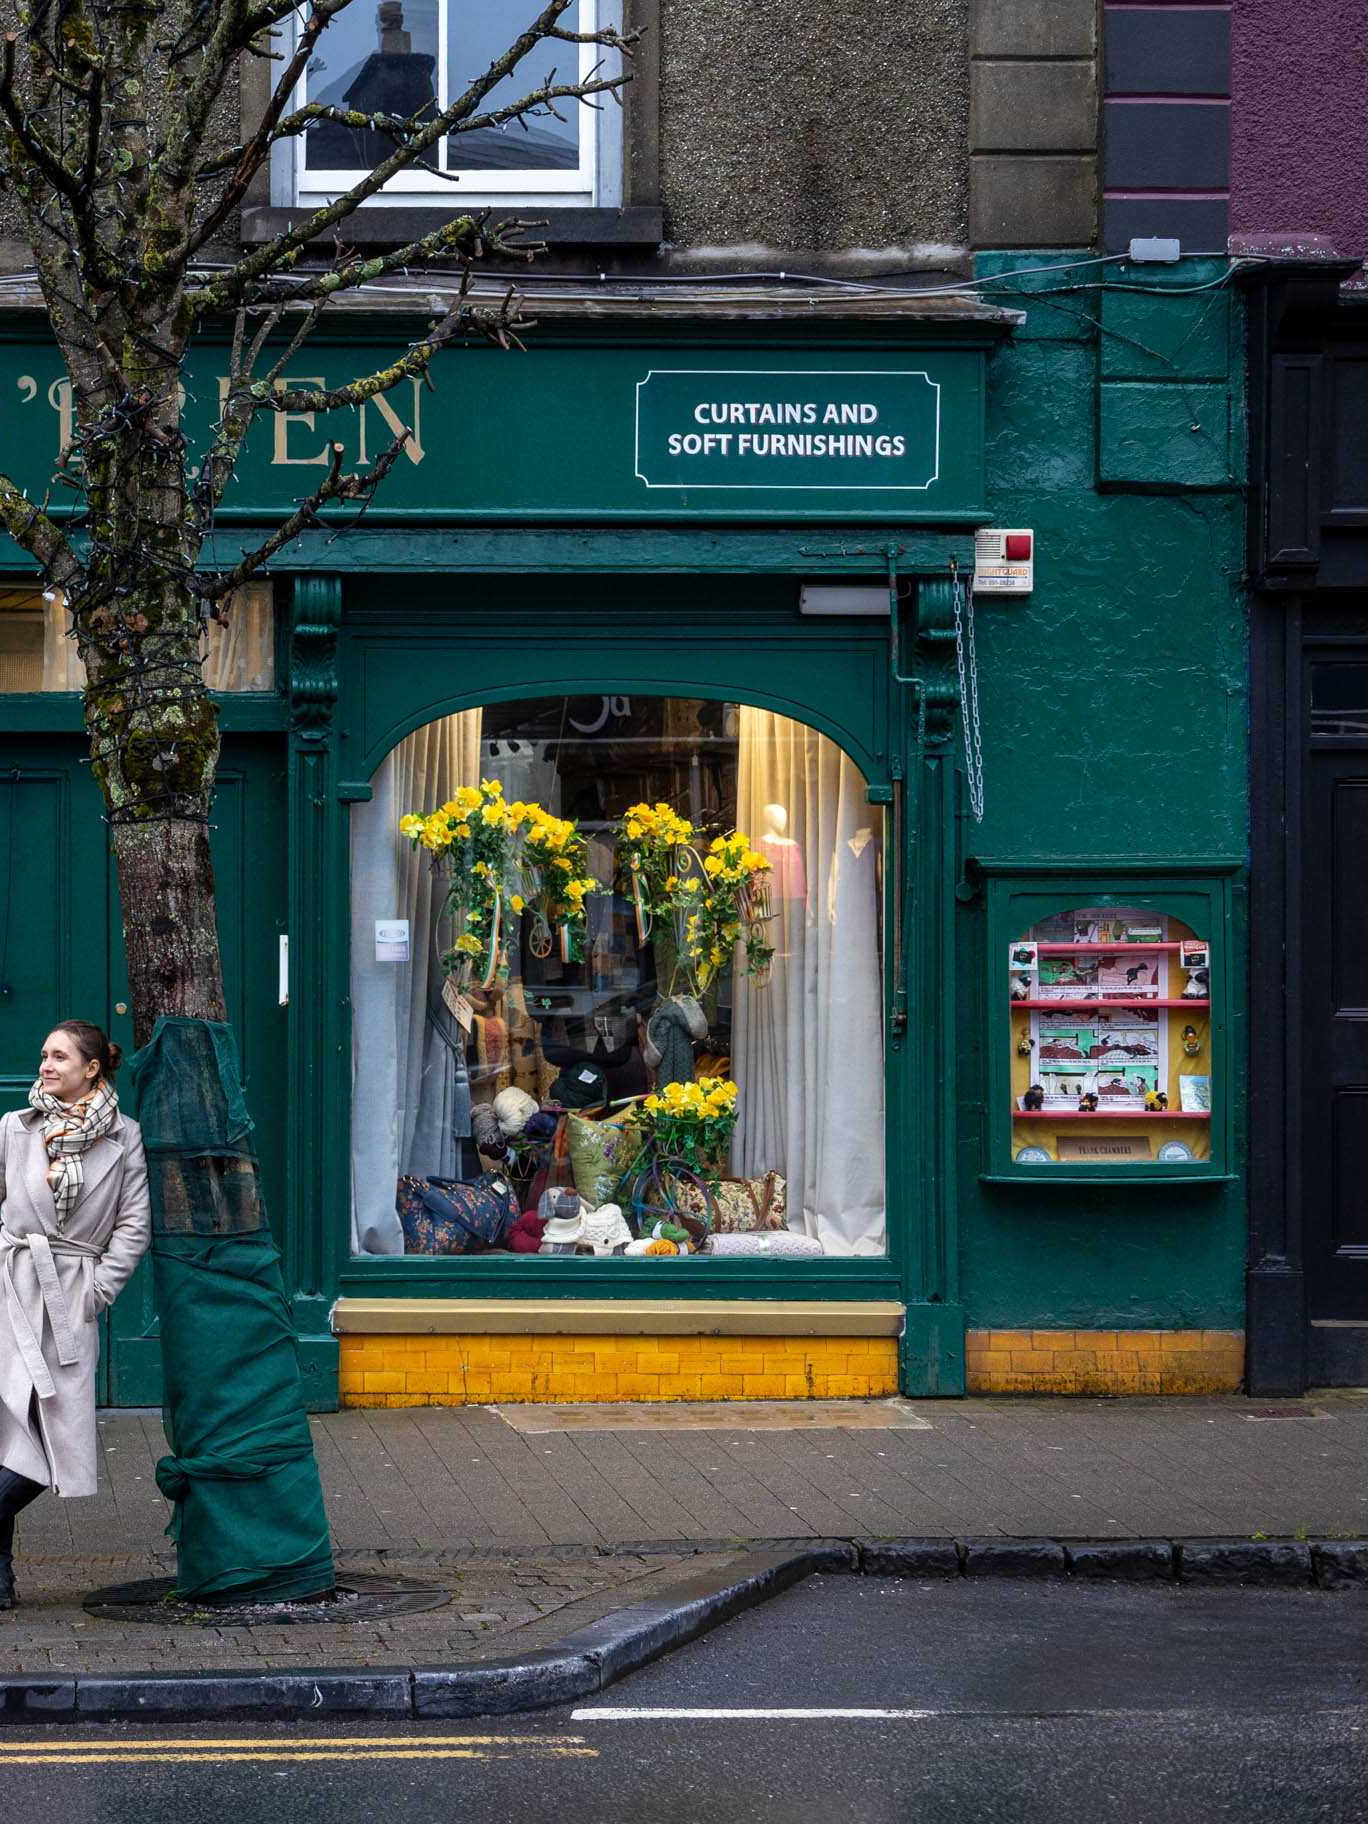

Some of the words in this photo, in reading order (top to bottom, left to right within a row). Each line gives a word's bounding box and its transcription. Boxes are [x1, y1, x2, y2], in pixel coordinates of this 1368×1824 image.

[693, 402, 818, 426] CURTAINS
[822, 402, 879, 426] AND
[667, 432, 733, 457] SOFT
[737, 433, 906, 458] FURNISHINGS
